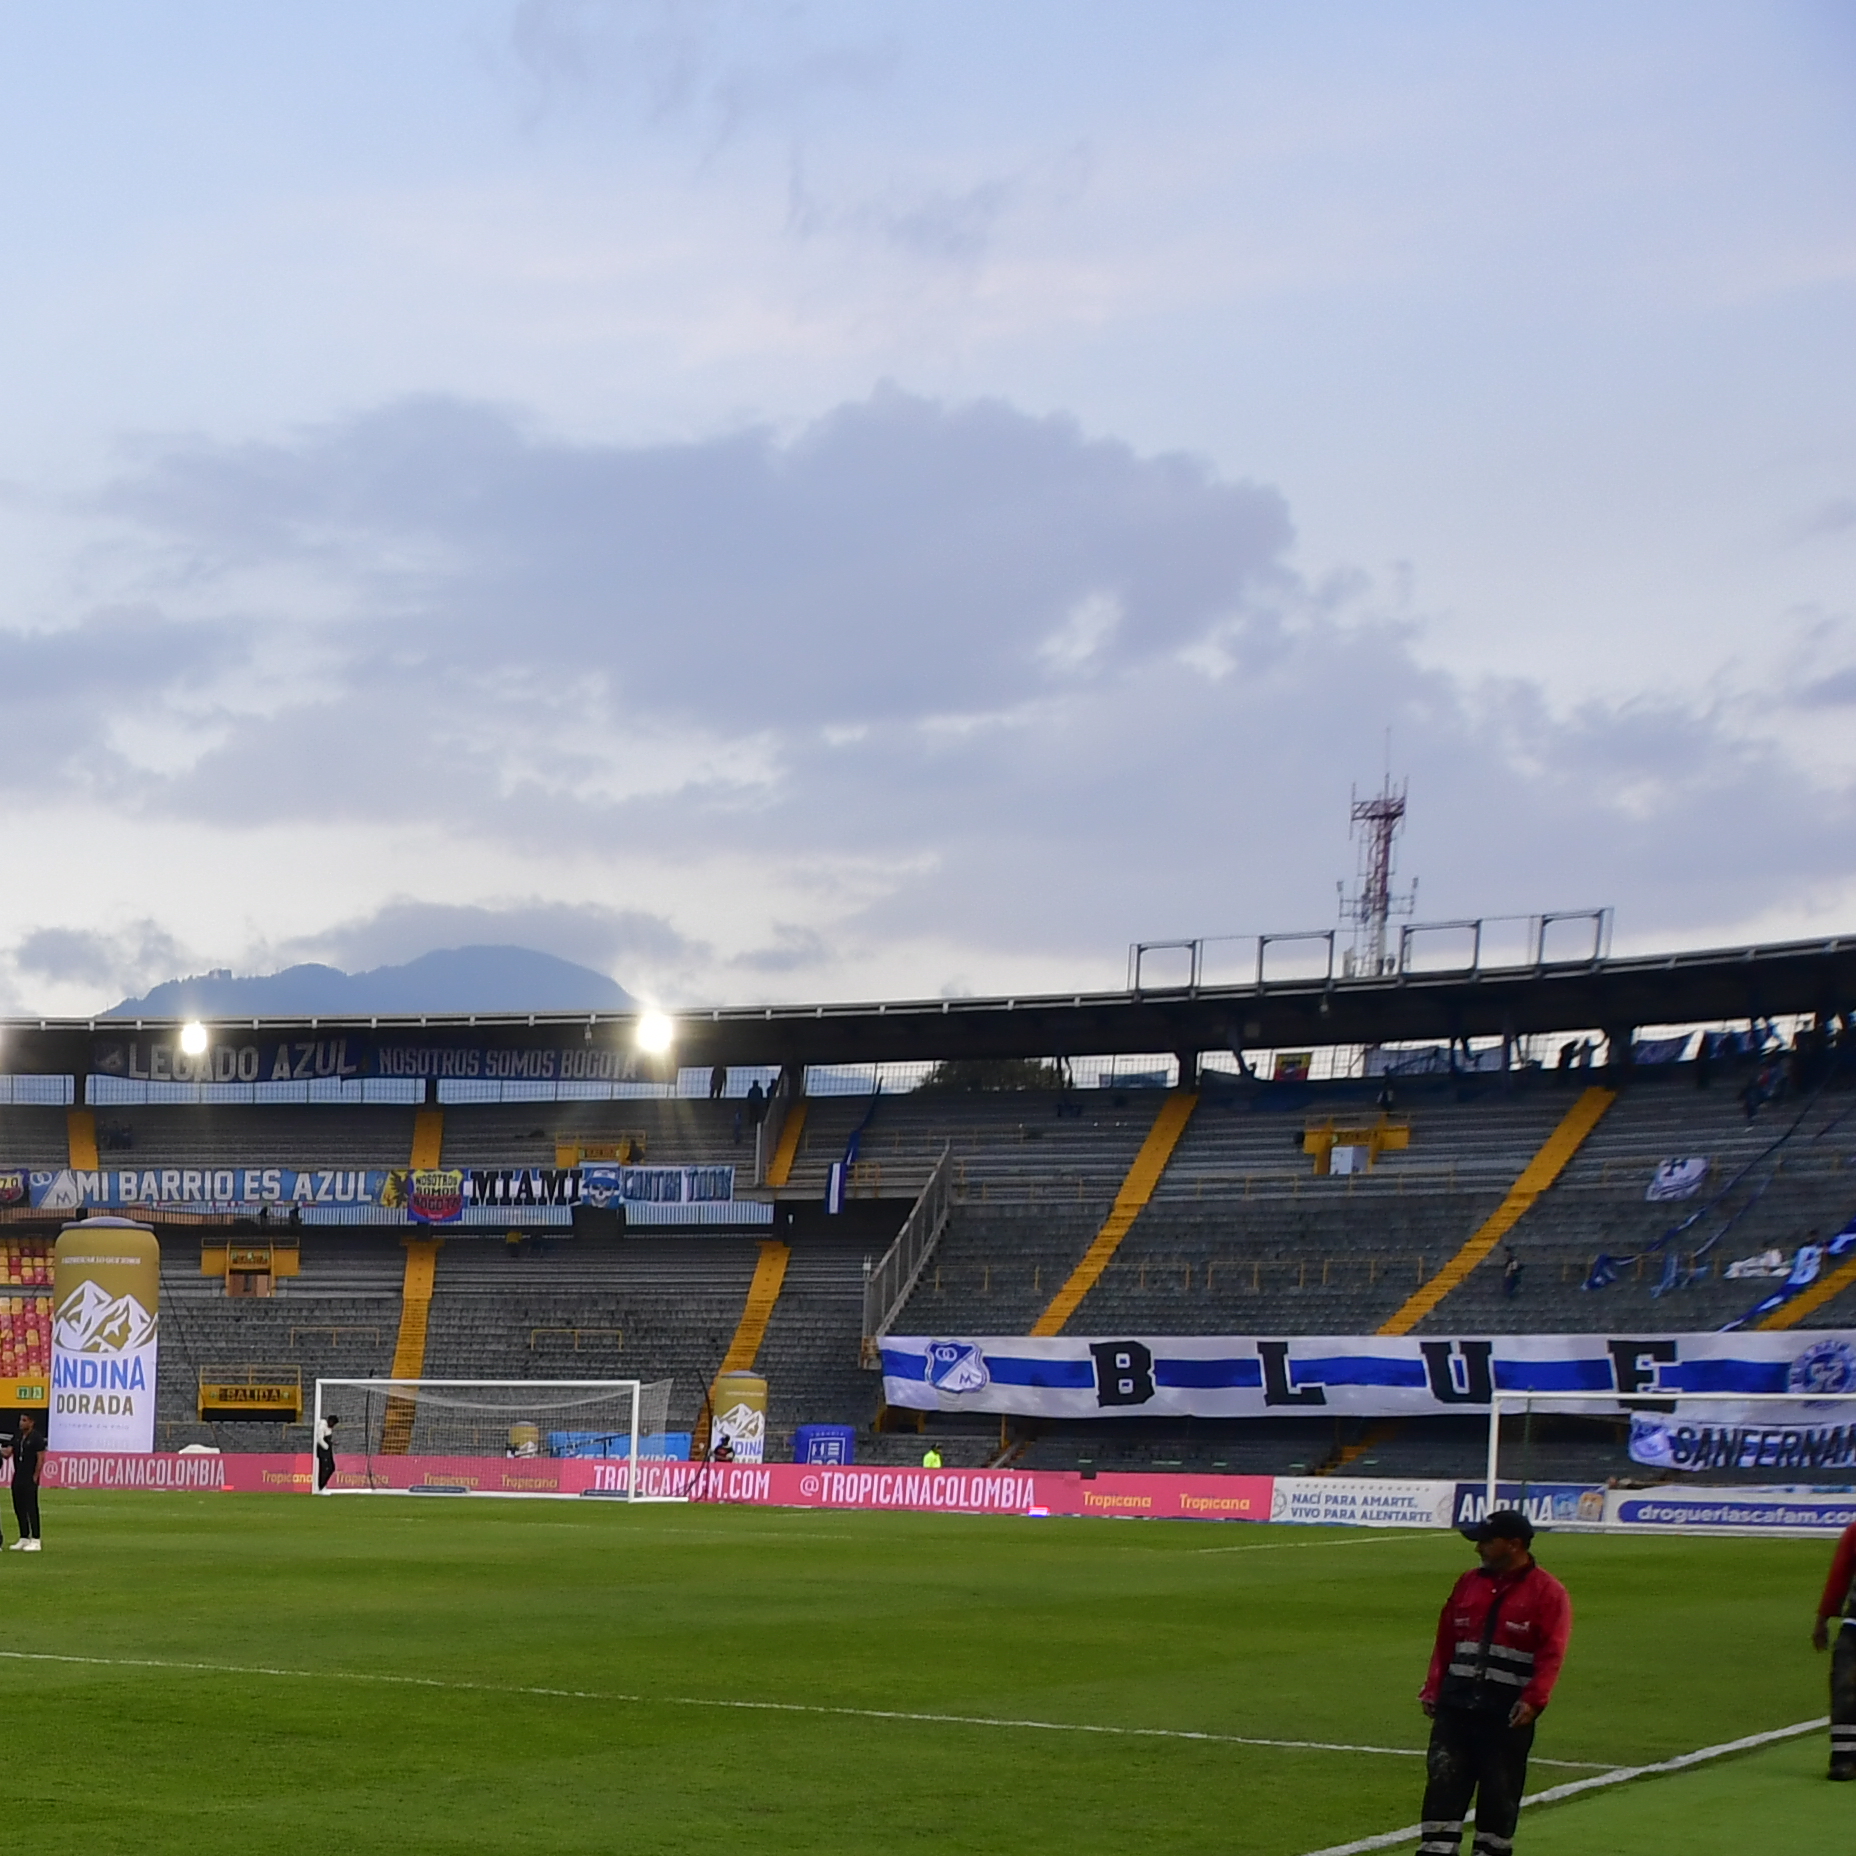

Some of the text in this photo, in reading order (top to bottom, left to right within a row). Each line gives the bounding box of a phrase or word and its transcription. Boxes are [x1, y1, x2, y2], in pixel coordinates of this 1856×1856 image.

[129, 1038, 357, 1082] LEGADO AZUL
[379, 1048, 480, 1076] NOSOTROS
[484, 1049, 555, 1077] SOMOS
[77, 1169, 372, 1201] MI BARRIO ES AZUL
[470, 1170, 584, 1205] MIAMI
[52, 1354, 145, 1391] ANDINA
[56, 1392, 134, 1416] DORADA
[43, 1457, 225, 1486] @TROPICANACOLOMBIA
[262, 1470, 313, 1485] Tropicana
[424, 1472, 479, 1487] Tropicana
[501, 1474, 558, 1489] Tropicana
[800, 1471, 1035, 1509] @TROPICANACOLOMBIA
[1083, 1491, 1151, 1508] Tropicana
[1180, 1493, 1250, 1511] Tropicana
[1292, 1491, 1322, 1505] NACÍ
[1325, 1494, 1357, 1506] PARA
[1291, 1507, 1432, 1522] VIVO PARA ALENTARTE
